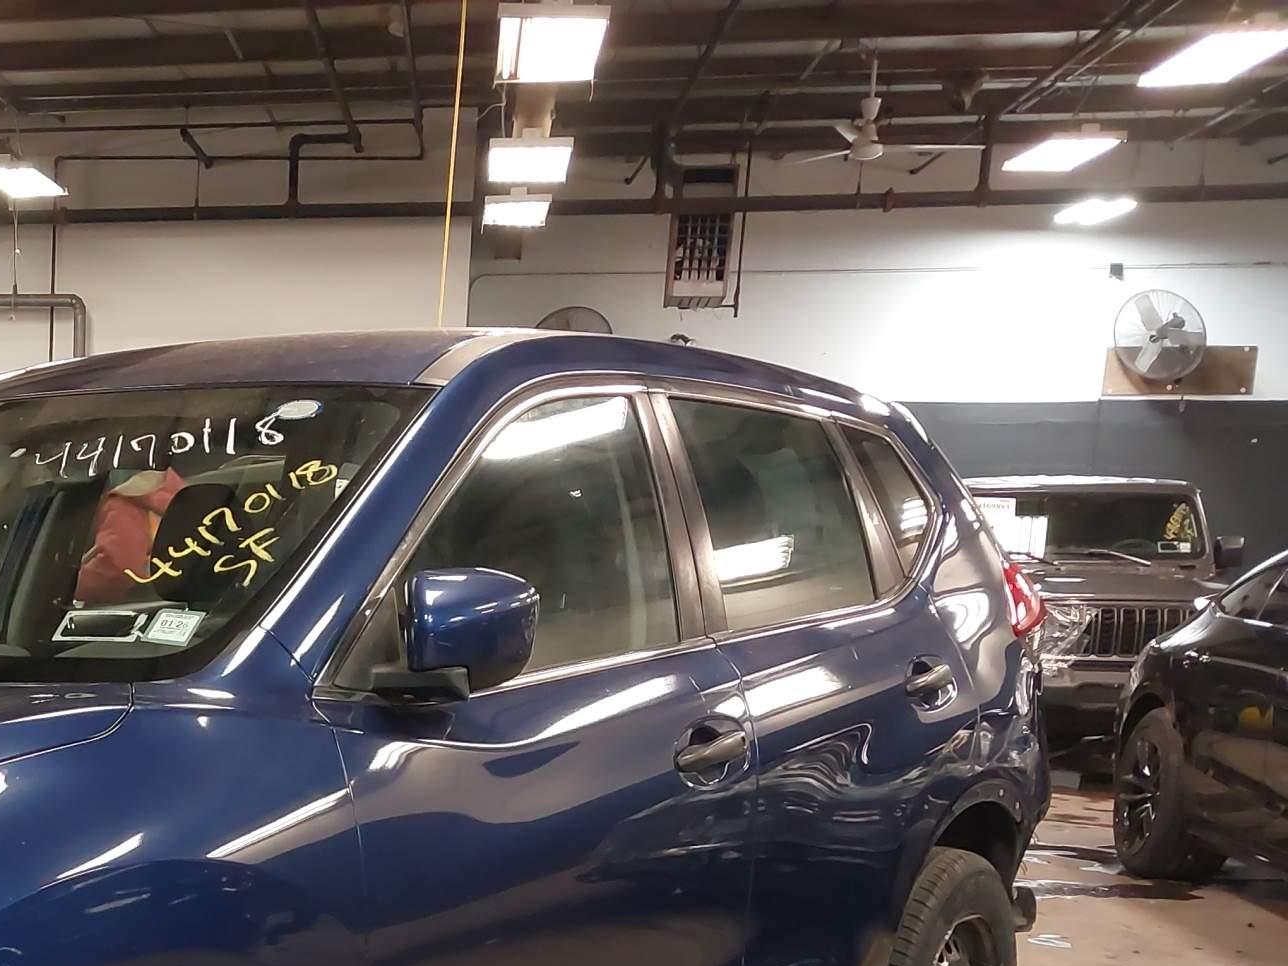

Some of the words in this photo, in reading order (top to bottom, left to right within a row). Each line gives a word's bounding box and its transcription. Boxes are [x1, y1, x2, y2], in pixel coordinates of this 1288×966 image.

[34, 415, 285, 479] 44170118
[123, 459, 338, 584] 44170118
[213, 527, 281, 587] SF
